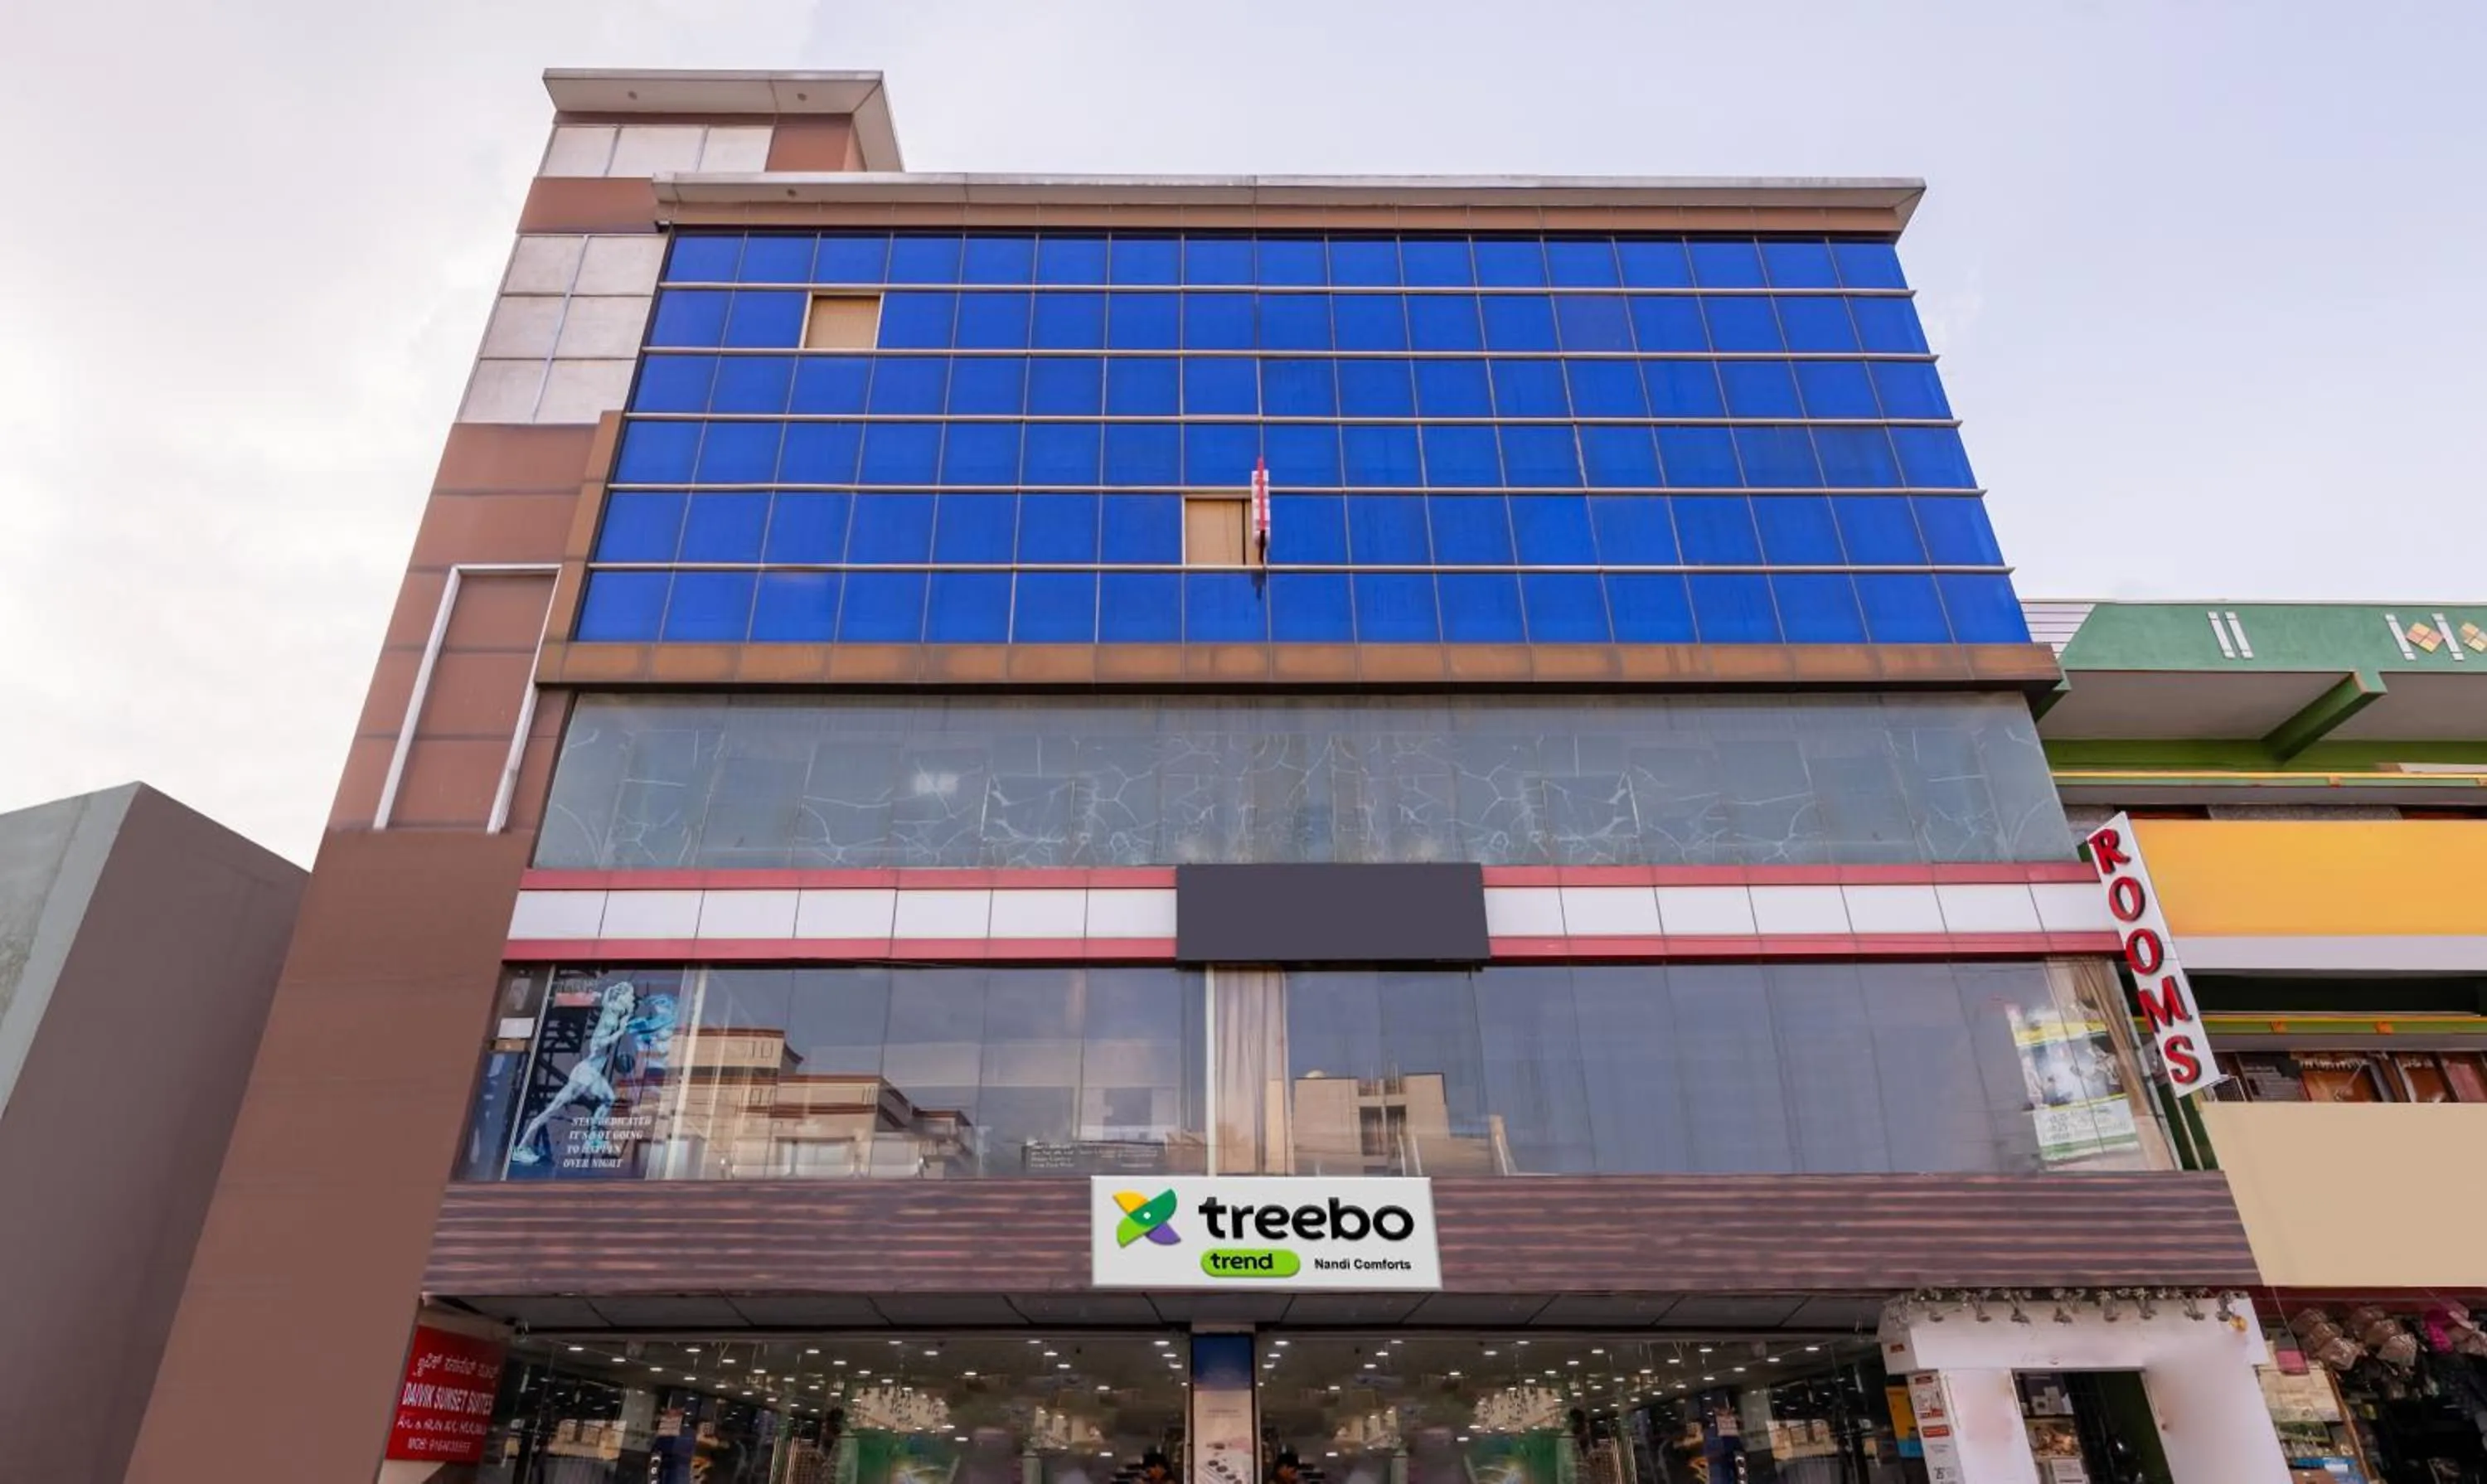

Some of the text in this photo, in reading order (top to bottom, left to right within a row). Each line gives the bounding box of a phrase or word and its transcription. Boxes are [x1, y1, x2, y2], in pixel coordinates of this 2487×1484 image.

[2088, 828, 2202, 1084] ROOMS
[563, 1158, 623, 1168] OVER NIGHT
[1199, 1196, 1414, 1241] treebo
[1210, 1253, 1274, 1270] trend
[1314, 1258, 1412, 1270] Nandi Comforts
[434, 1385, 468, 1414] SUNSET
[467, 1390, 495, 1417] SUITES
